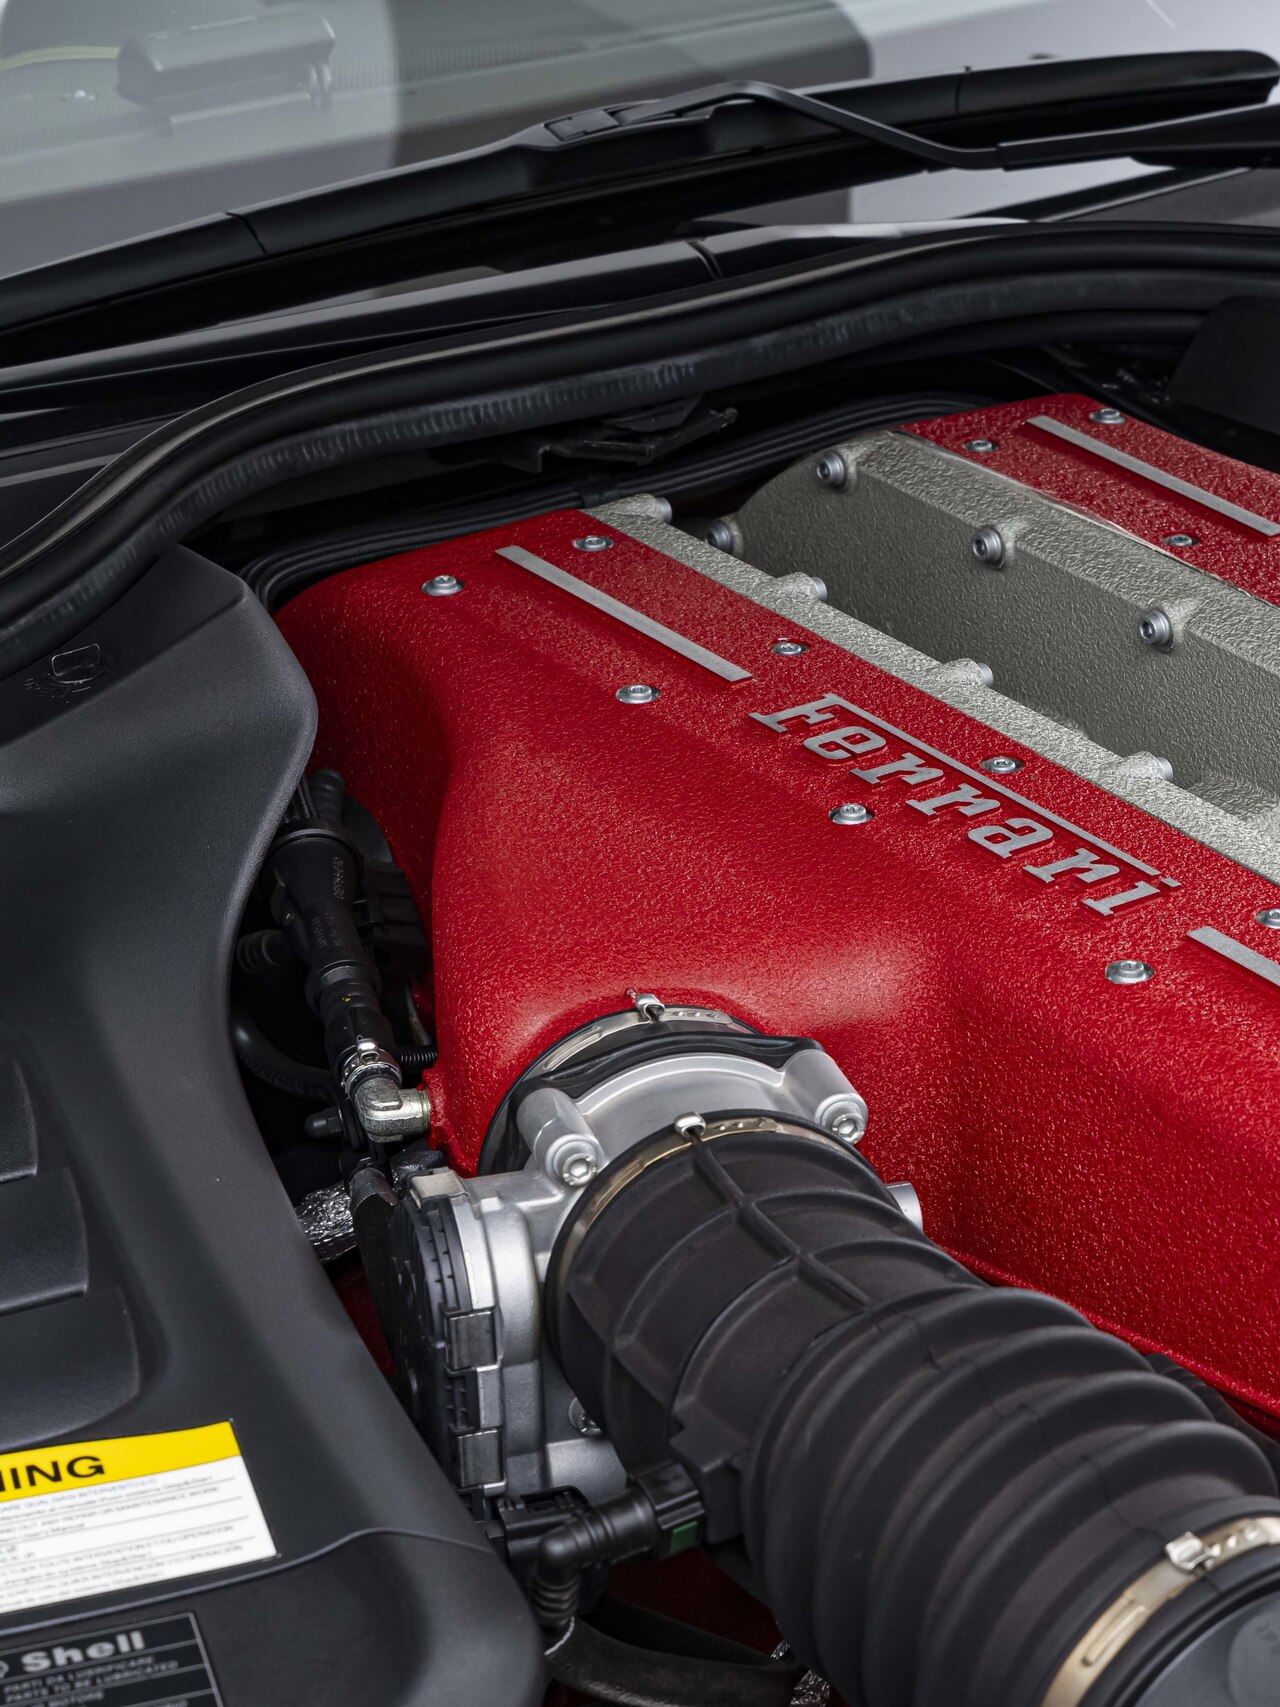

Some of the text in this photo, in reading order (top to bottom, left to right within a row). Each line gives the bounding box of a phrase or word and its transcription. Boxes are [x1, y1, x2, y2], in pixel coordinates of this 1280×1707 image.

[749, 693, 1182, 917] Ferrari
[0, 1456, 105, 1492] ING
[21, 1630, 146, 1673] Shell
